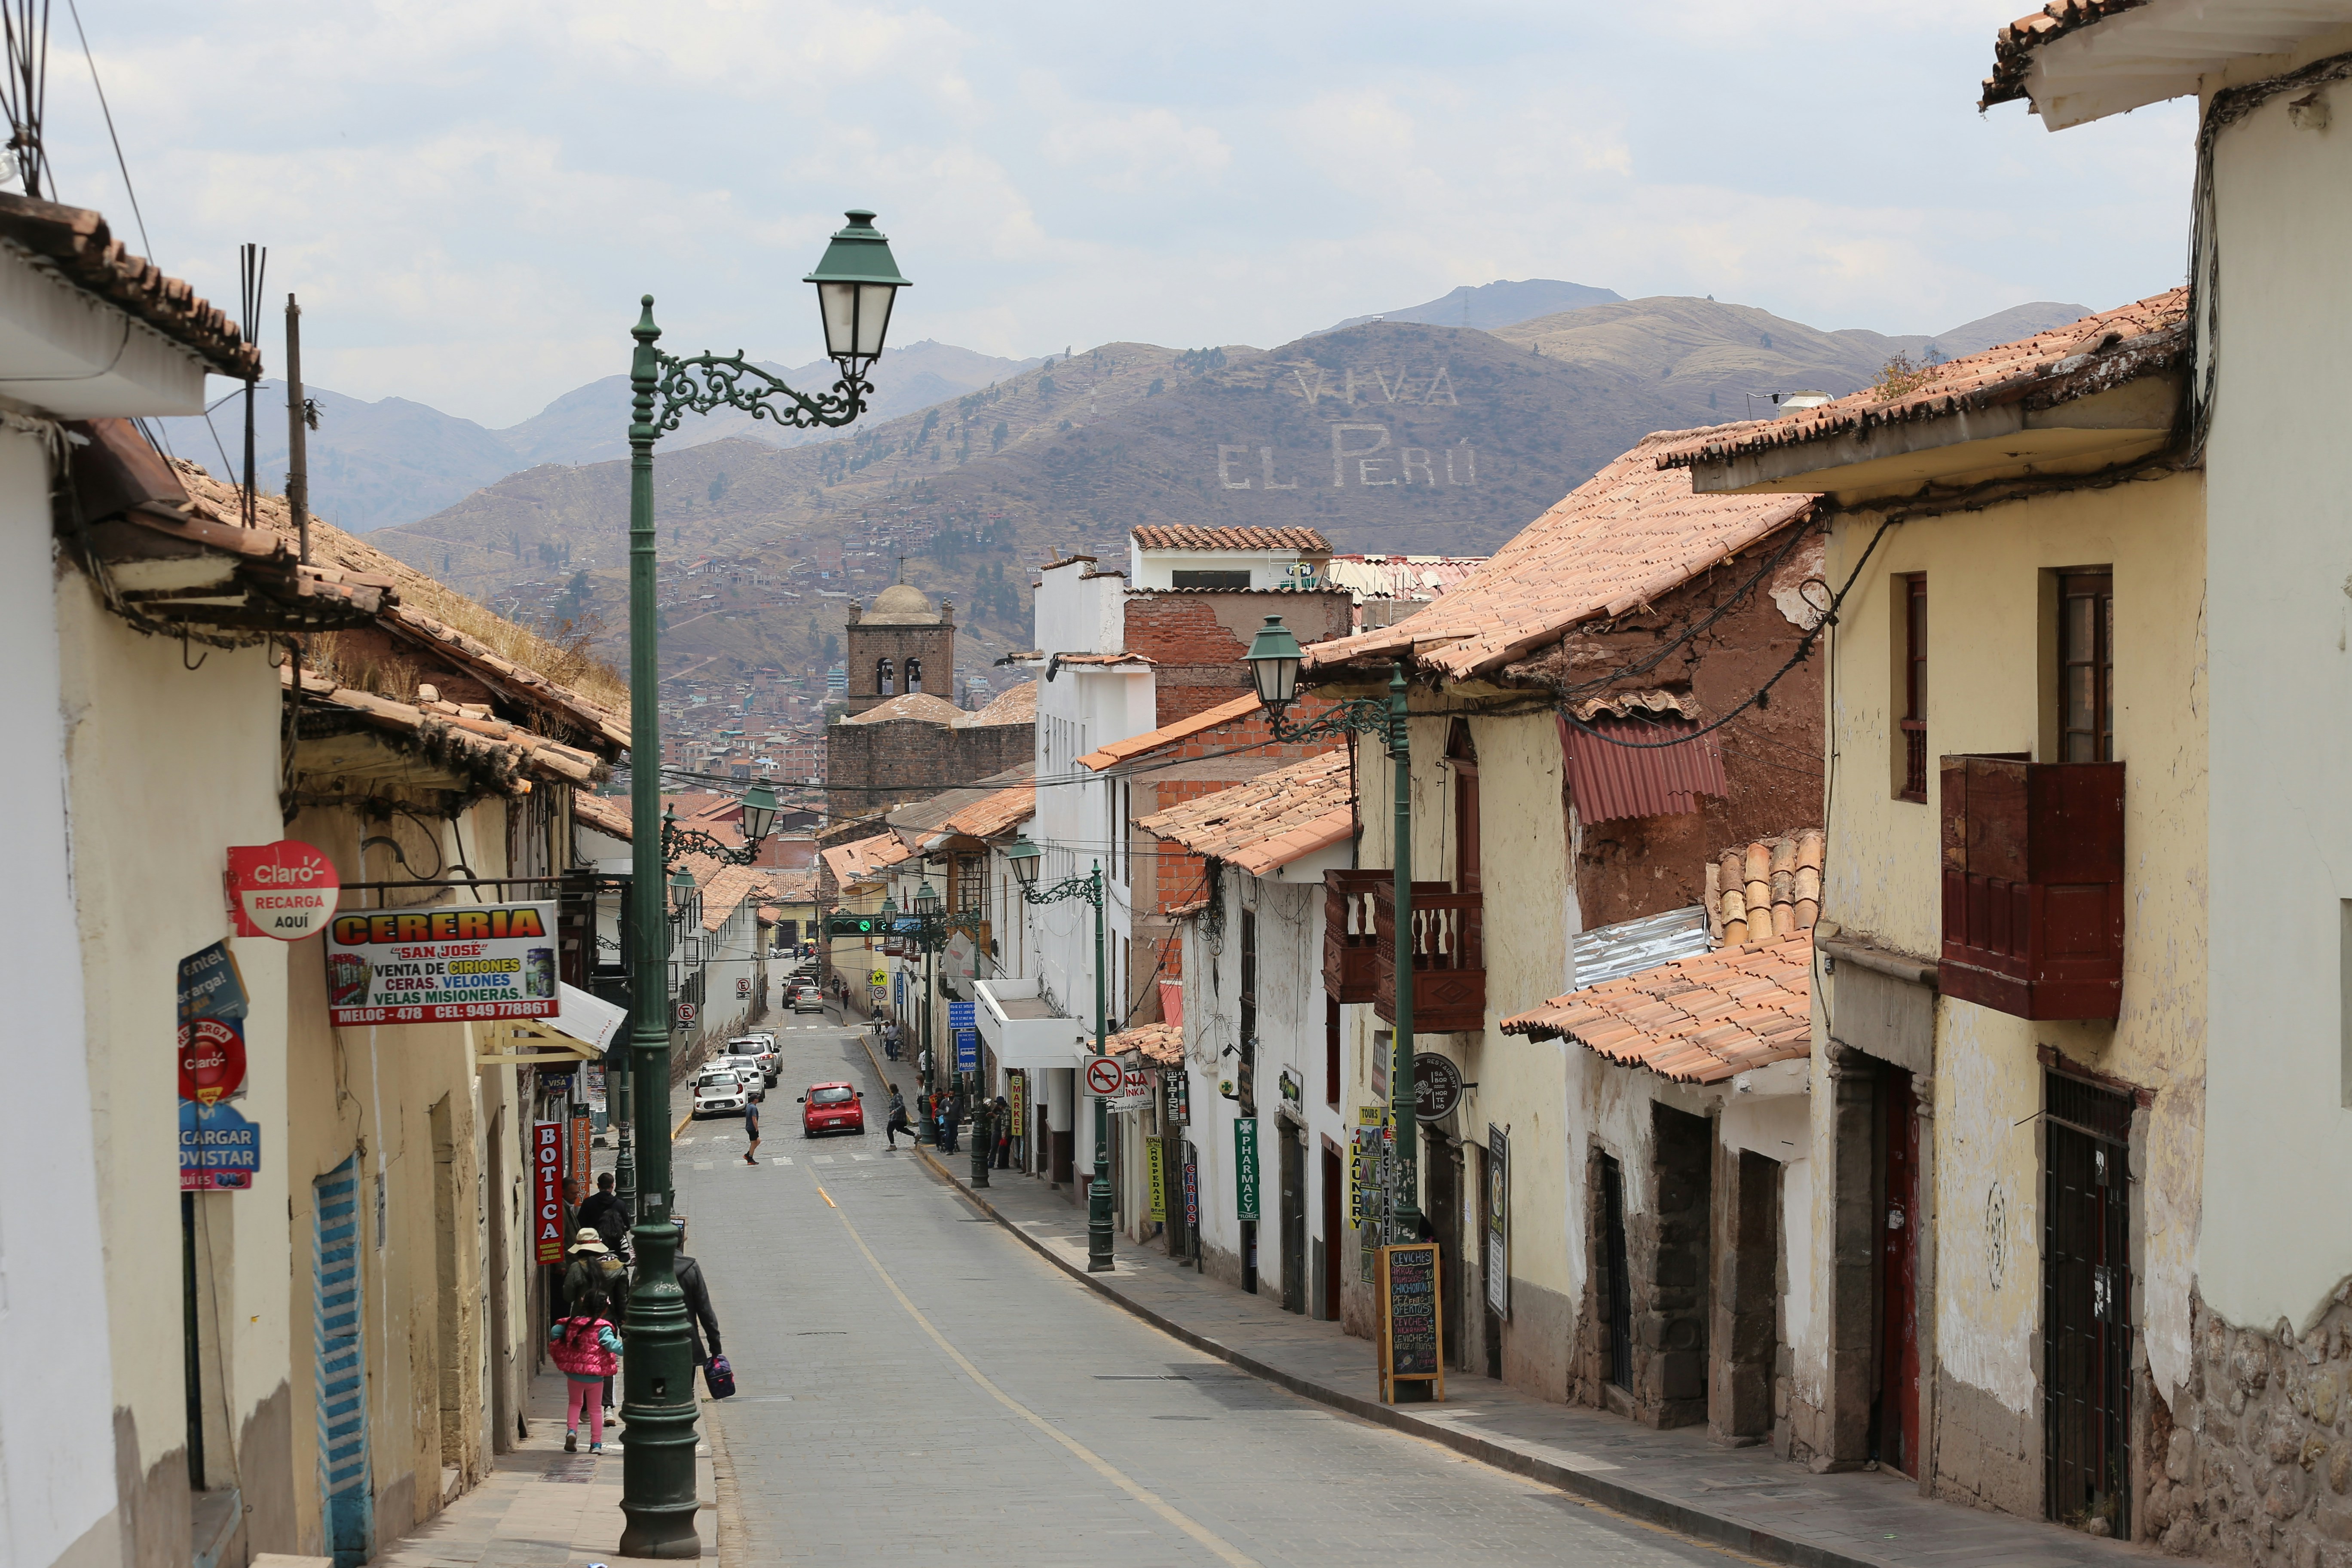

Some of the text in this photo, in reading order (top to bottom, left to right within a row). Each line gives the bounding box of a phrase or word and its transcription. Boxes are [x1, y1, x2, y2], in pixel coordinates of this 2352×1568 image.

[1293, 365, 1458, 405] VIVA
[1217, 444, 1298, 489] EL
[254, 861, 316, 883] Claro
[255, 896, 325, 909] RECARGA
[275, 912, 309, 928] AQUÍ
[333, 908, 546, 945] CERERIA
[183, 949, 225, 976] entel
[374, 959, 520, 977] VENTA DE CIRIONES
[386, 974, 510, 991] CERAS, VELONES
[374, 988, 523, 1005] VELAS MISIONERAS.
[339, 1008, 385, 1022] MELOC
[397, 1008, 423, 1020] 478
[435, 1006, 463, 1018] CEL:
[466, 1004, 495, 1017] 949
[497, 1002, 549, 1015] 778861
[178, 1024, 228, 1045] REARGA
[1374, 1042, 1385, 1070] FREE
[1427, 1059, 1457, 1089] RESTAURANT
[1126, 1088, 1145, 1097] INKA
[1167, 1076, 1179, 1120] CIRIONES
[1362, 1108, 1378, 1119] TOURS
[577, 1120, 586, 1204] FHARMACY
[541, 1128, 559, 1239] BOTICA
[1151, 1149, 1160, 1207] HOSPEDAJE
[1242, 1136, 1253, 1211] PHARMACY
[1186, 1164, 1196, 1222] CIRIOS
[1352, 1145, 1361, 1229] LAUNDRY
[1393, 1252, 1431, 1264] CEVICHES
[1391, 1267, 1414, 1276] ARROZ
[1425, 1269, 1433, 1280] 10
[1393, 1295, 1408, 1304] PEZ
[1393, 1333, 1429, 1343] CEVICHES
[1427, 1325, 1434, 1333] 15
